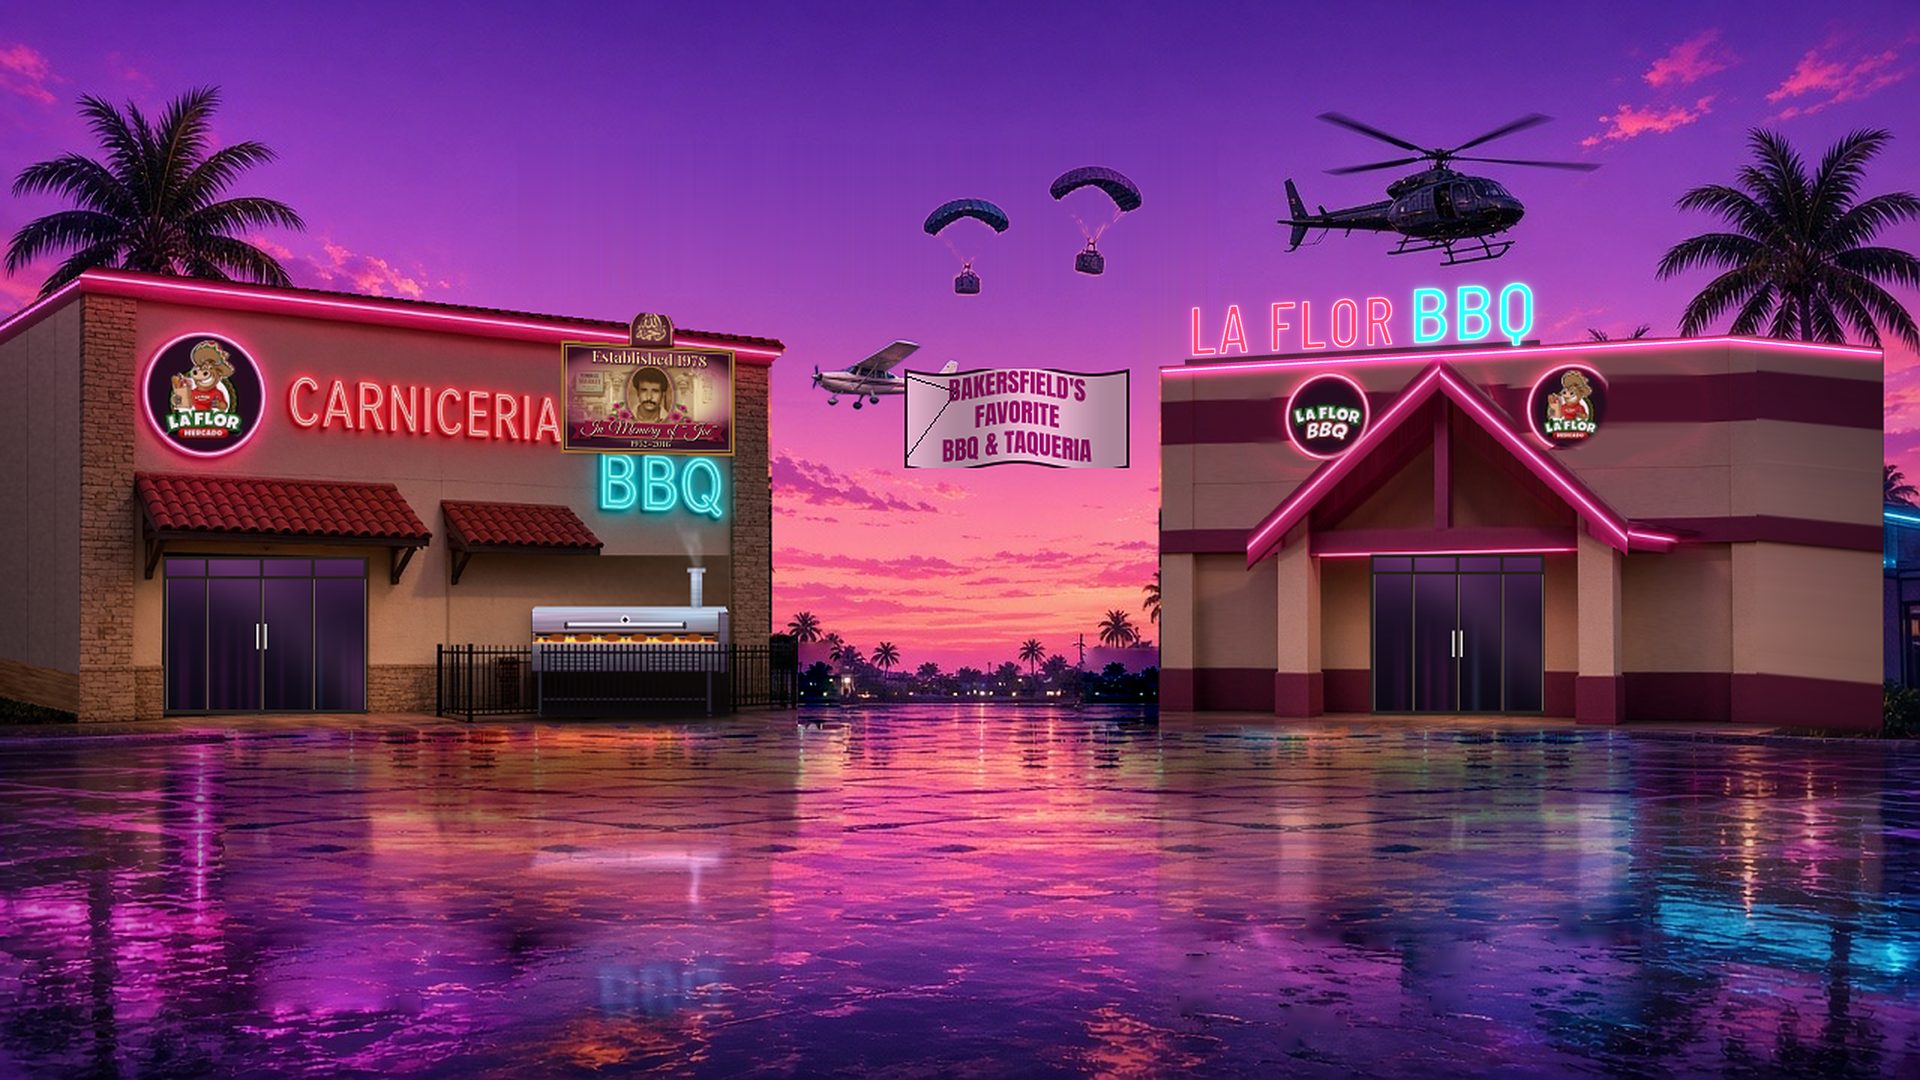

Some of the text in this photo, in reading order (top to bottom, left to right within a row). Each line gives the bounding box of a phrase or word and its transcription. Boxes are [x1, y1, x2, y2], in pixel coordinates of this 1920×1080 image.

[1190, 282, 1535, 357] LA FLOR BBQ
[592, 350, 708, 368] Established 1978
[949, 370, 1087, 402] BAKERSFIELD'S
[168, 411, 240, 430] LA FLOR
[289, 376, 562, 443] CARNICERIA
[974, 399, 1060, 429] FAVORITE
[1295, 406, 1360, 423] LA FLOR
[183, 428, 223, 437] MERCADO
[580, 421, 604, 437] In
[608, 419, 661, 440] Memory
[667, 423, 678, 441] of
[1306, 421, 1348, 440] BBQ
[1545, 420, 1597, 433] LA FLOR
[942, 429, 1092, 462] BBQ & TAQUERIA
[599, 453, 723, 518] BBQ
